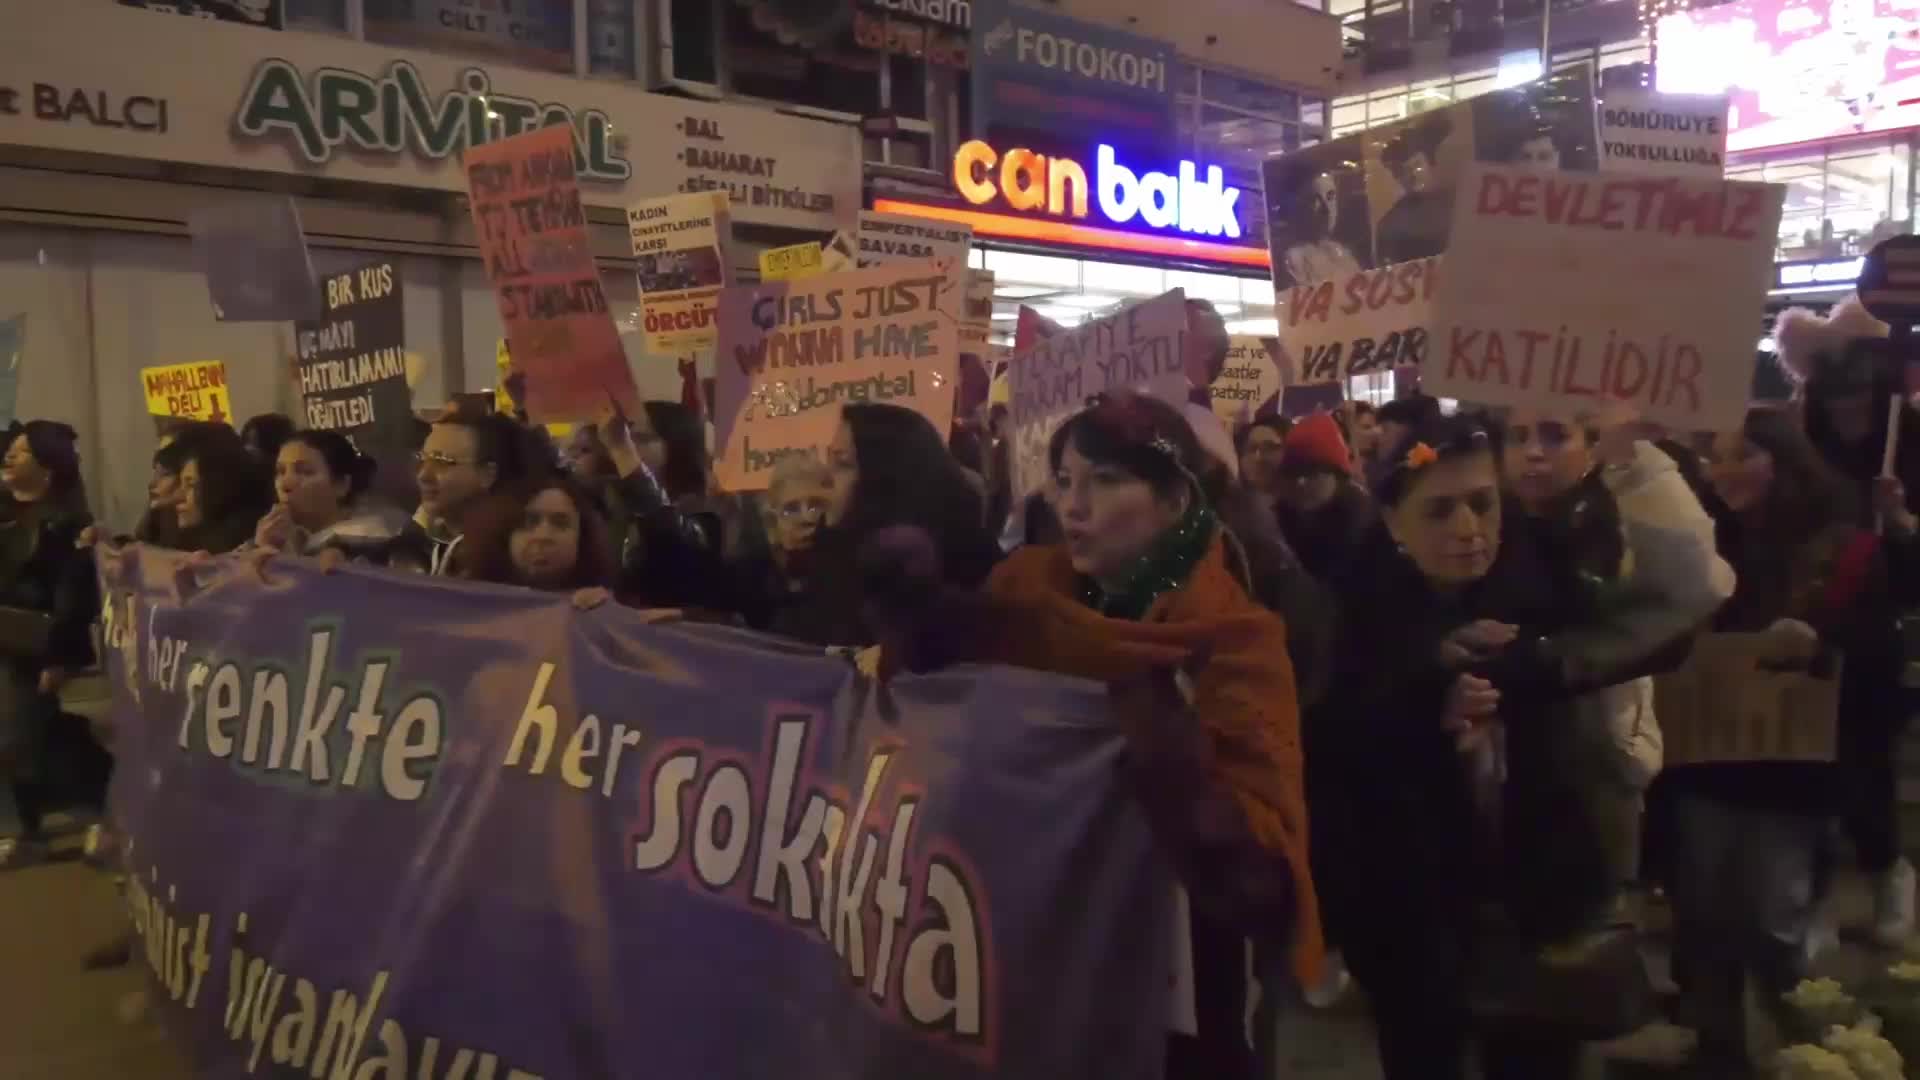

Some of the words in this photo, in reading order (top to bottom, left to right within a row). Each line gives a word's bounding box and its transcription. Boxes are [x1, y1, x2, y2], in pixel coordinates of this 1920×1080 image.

[1016, 27, 1166, 93] FOTOKOPİ
[33, 82, 169, 135] BALCI
[684, 116, 725, 141] BAL
[685, 146, 777, 178] BAHARAT
[954, 139, 1088, 218] can
[629, 205, 668, 222] KADIN
[327, 274, 355, 310] BİR
[751, 288, 844, 331] GIRLS
[852, 275, 948, 319] JUST
[853, 320, 940, 361] HAVE
[178, 630, 441, 801] renkte
[503, 662, 641, 798] her
